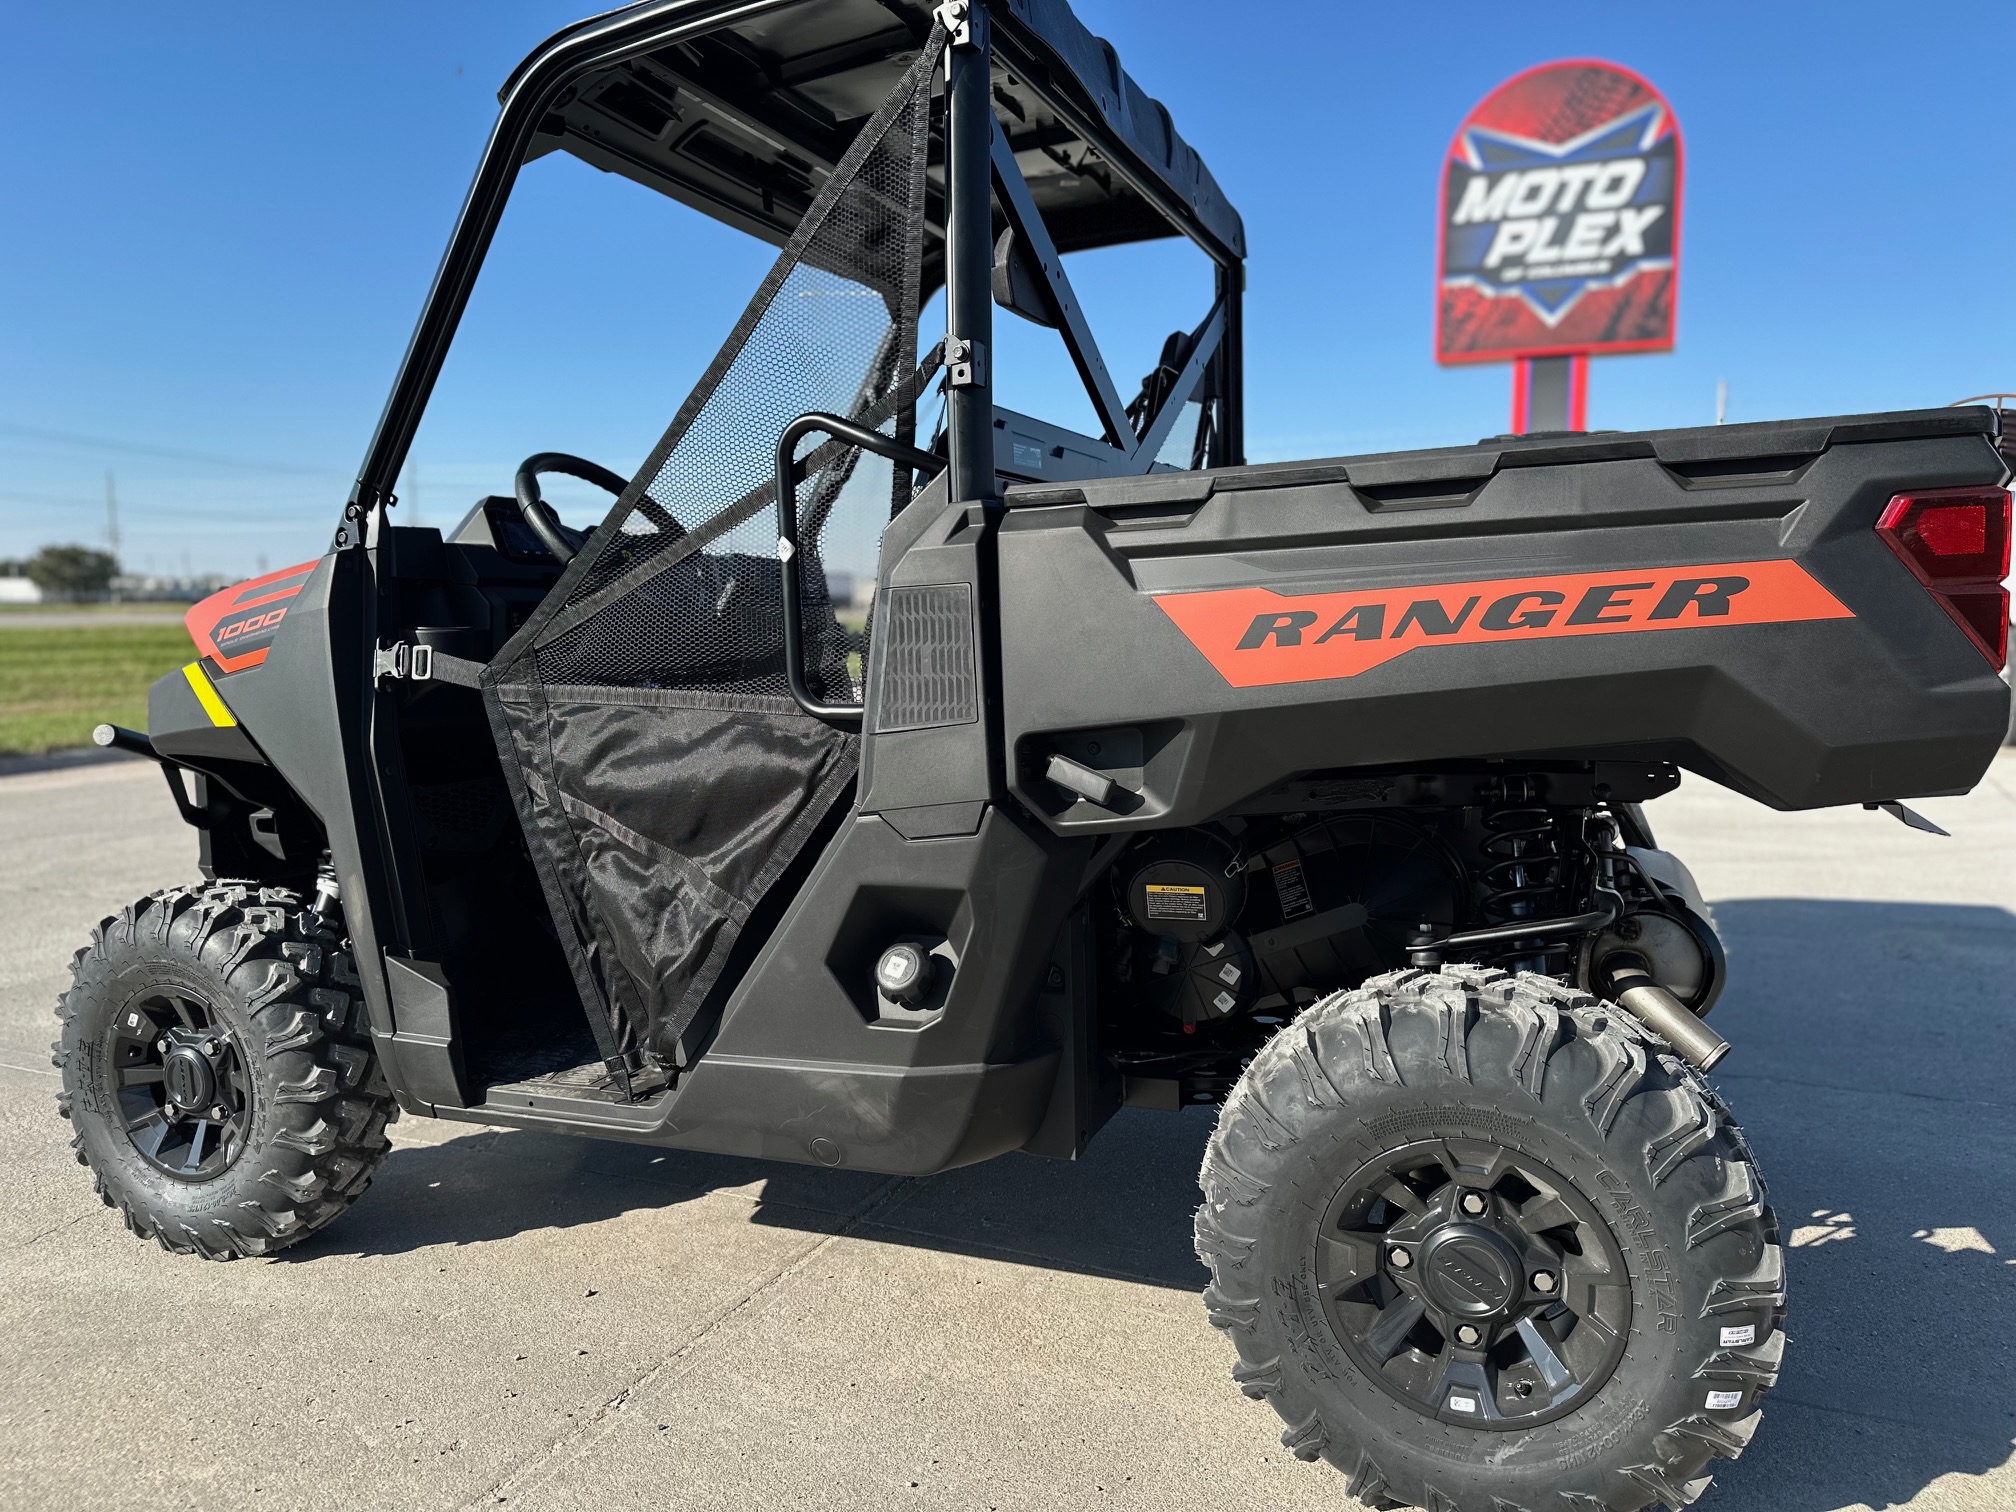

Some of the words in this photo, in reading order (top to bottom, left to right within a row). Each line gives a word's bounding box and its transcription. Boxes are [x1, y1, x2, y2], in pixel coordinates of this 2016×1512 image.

[1453, 158, 1647, 225] MOTO
[1484, 205, 1665, 268] PLEX
[217, 607, 288, 642] 1000
[1235, 576, 1750, 650] RANGER
[1596, 1169, 1677, 1334] CARLSTAR
[1611, 1201, 1641, 1249] DESIGNED
[1639, 1251, 1649, 1267] IN
[1302, 1285, 1311, 1302] USE
[1306, 1308, 1318, 1327] UTV
[1316, 1330, 1326, 1344] OR
[1723, 1336, 1753, 1344] CARLSTAR
[1326, 1348, 1342, 1366] ATV
